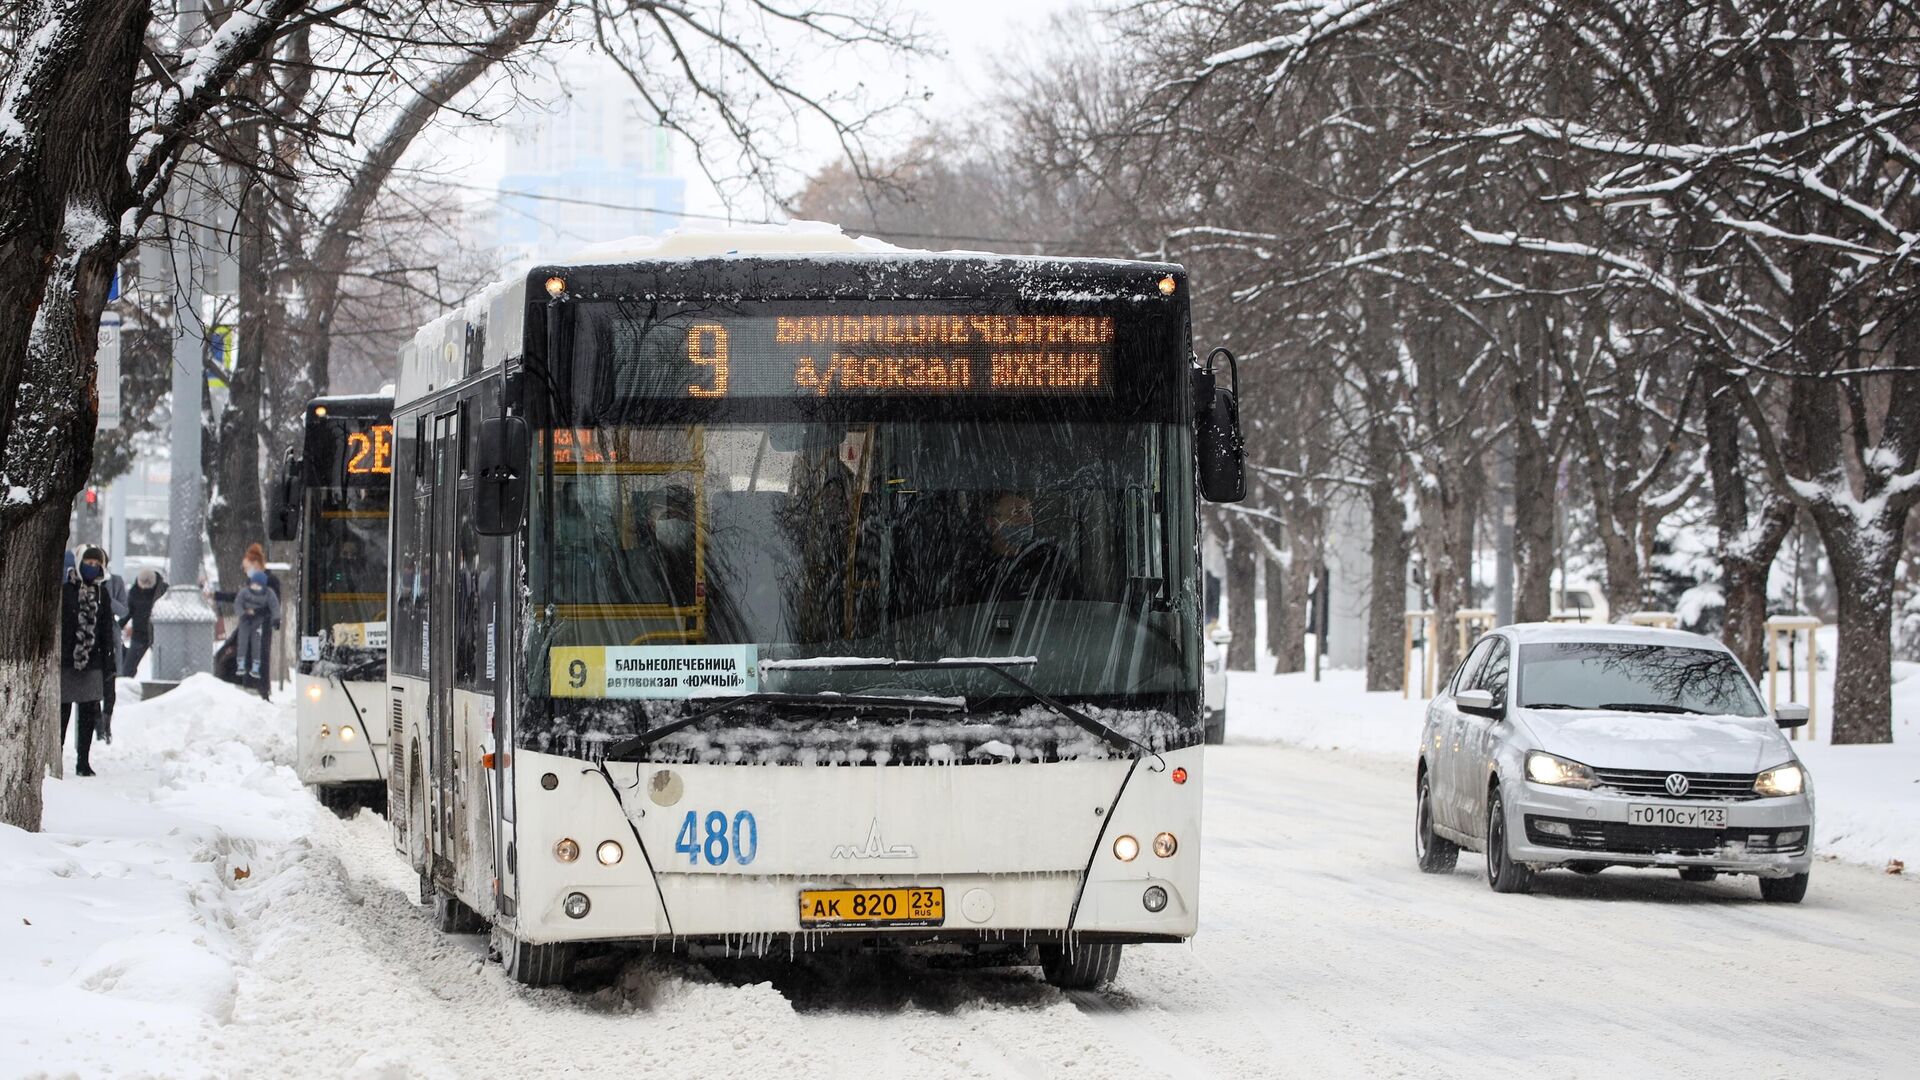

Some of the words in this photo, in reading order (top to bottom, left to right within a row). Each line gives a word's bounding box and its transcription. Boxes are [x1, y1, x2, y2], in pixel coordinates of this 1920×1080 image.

[688, 324, 728, 397] 9
[991, 353, 1099, 386] ЮЖНЫЙ
[568, 659, 587, 688] 9
[615, 658, 736, 672] БАЛЬНЕОЛЕЧЕБНИЦА
[607, 677, 678, 688] автовокзал
[1700, 809, 1723, 822] 123
[675, 810, 757, 865] 480
[813, 899, 840, 917] АК
[852, 894, 897, 916] 820
[911, 891, 934, 909] 23
[914, 909, 931, 917] RUS
